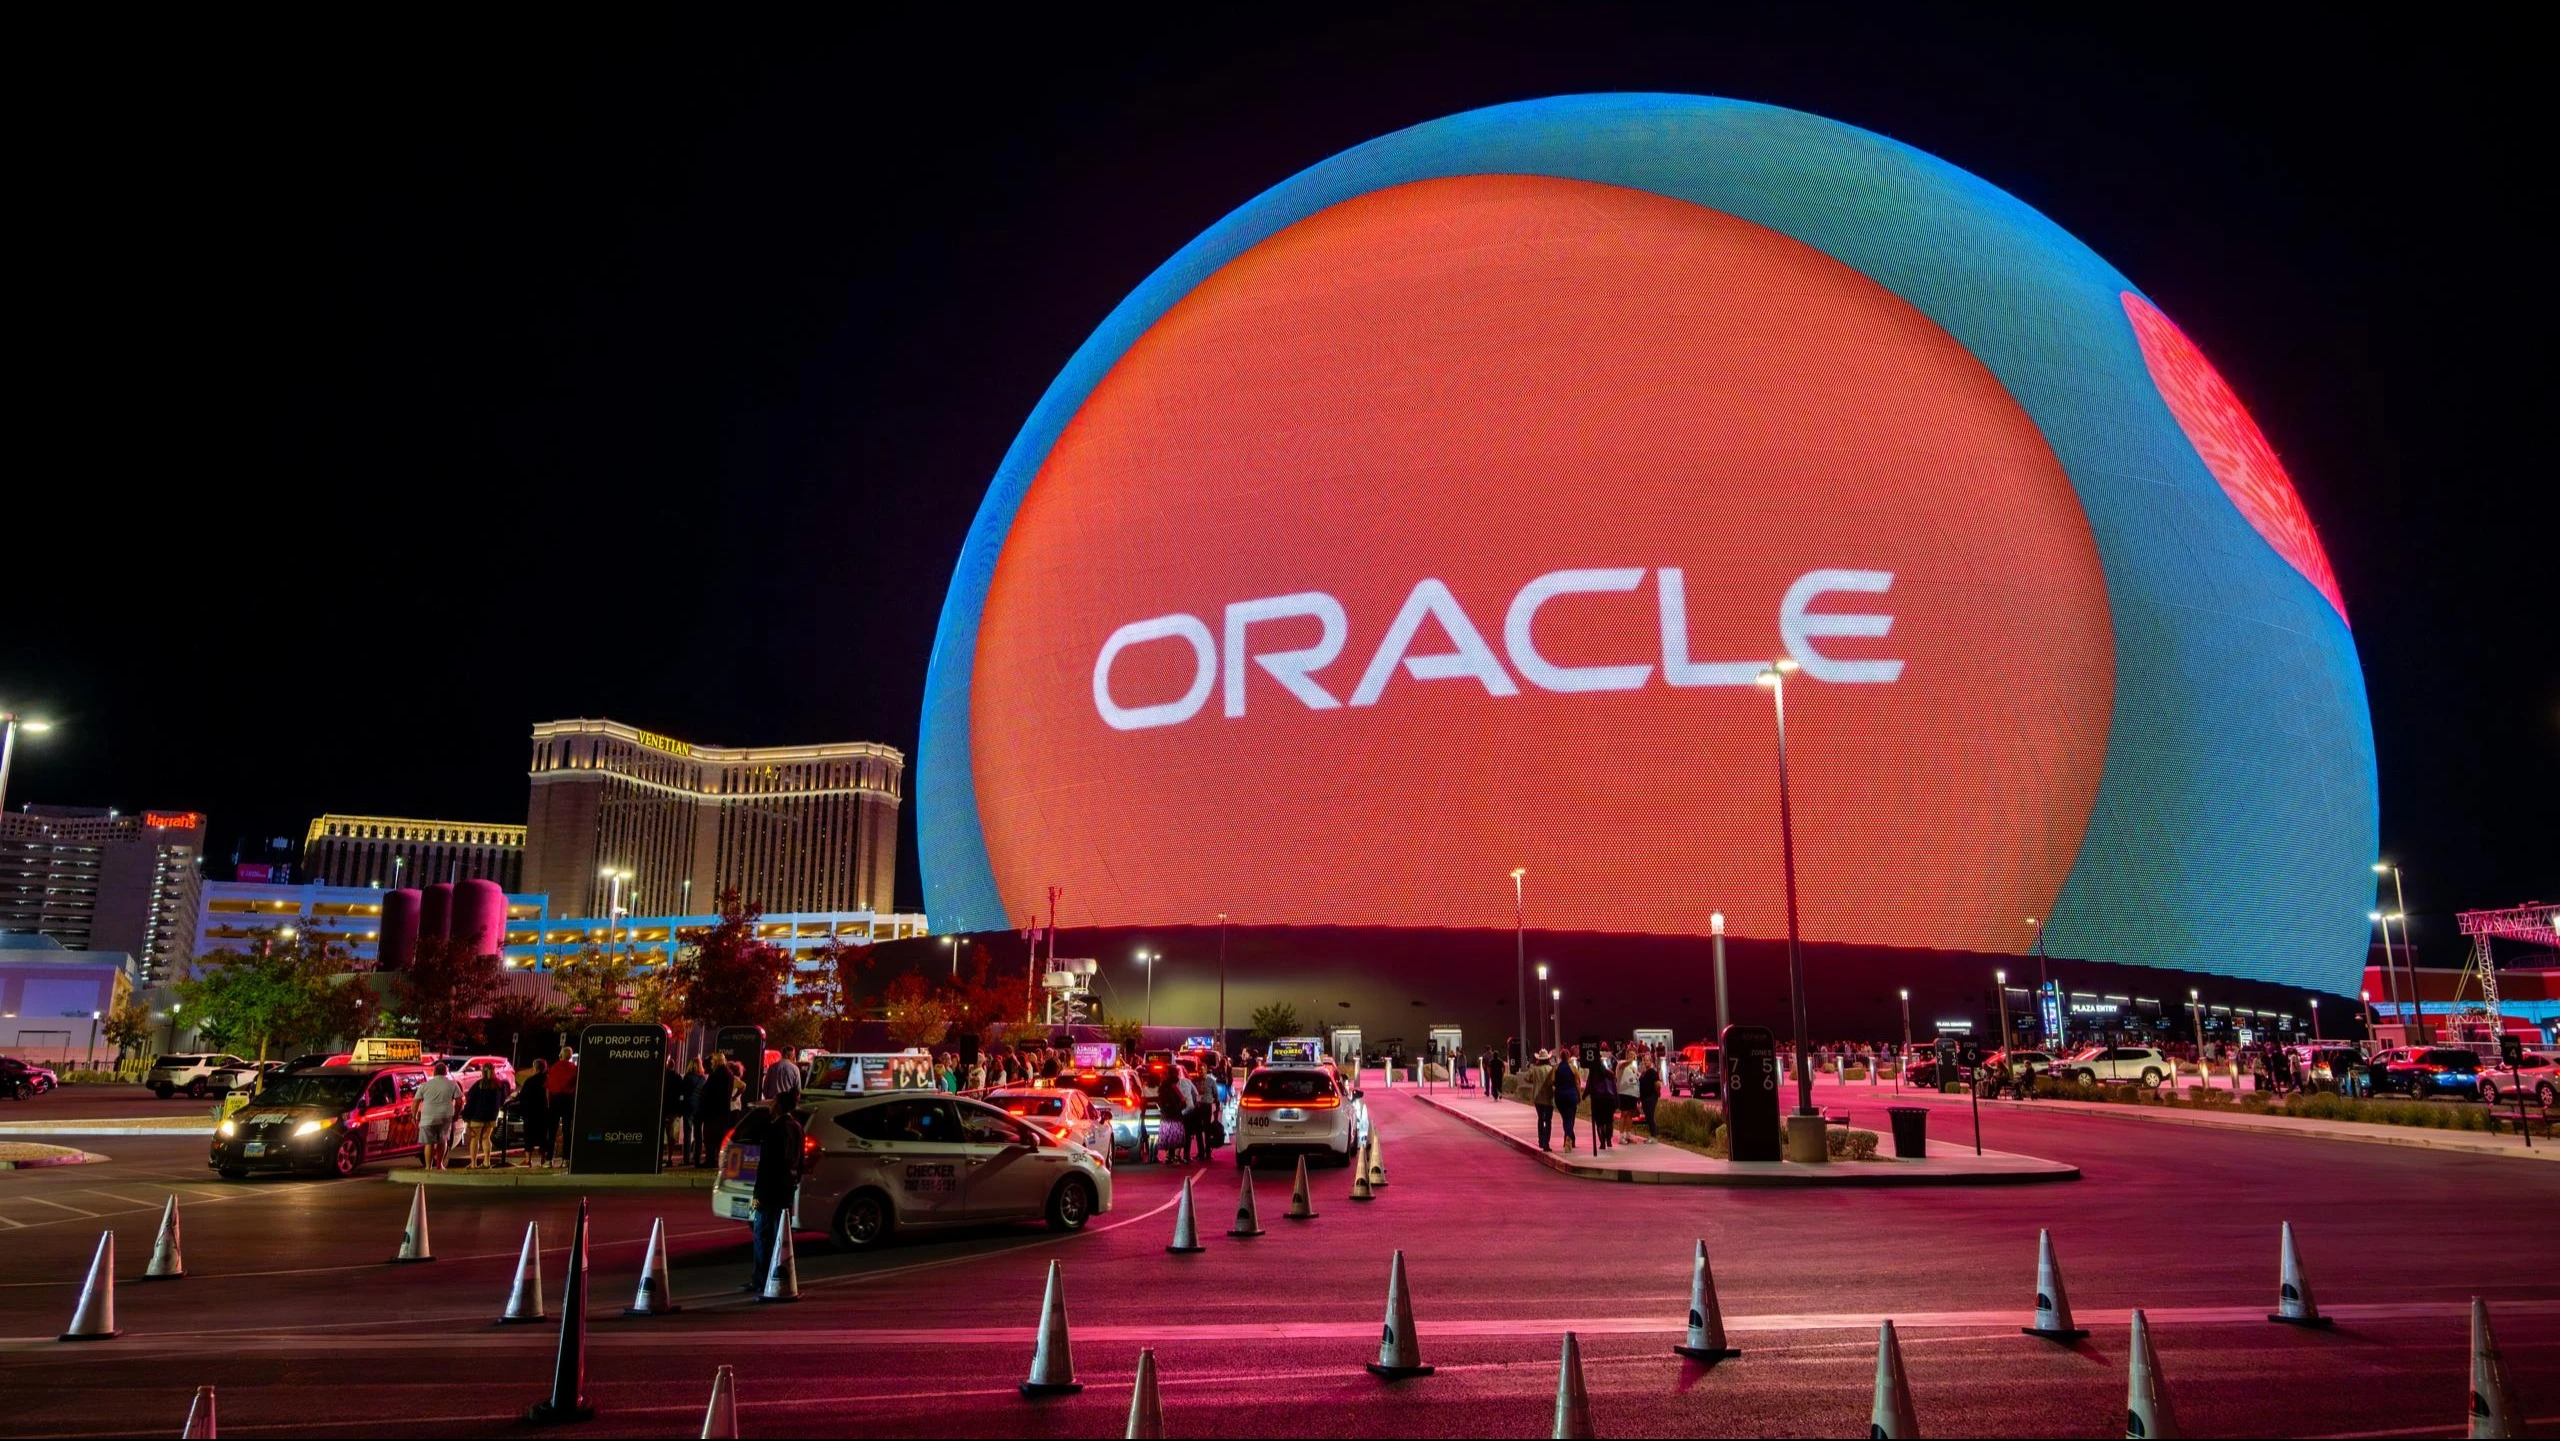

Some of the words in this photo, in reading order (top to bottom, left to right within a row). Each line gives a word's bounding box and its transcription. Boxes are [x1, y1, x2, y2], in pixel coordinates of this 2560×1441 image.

[1092, 567, 1906, 731] ORACLE
[639, 730, 689, 757] VENETIAN
[2072, 1004, 2095, 1012] PLAZA
[2096, 1004, 2117, 1012] ENTRY
[588, 1035, 603, 1045] VIP
[605, 1035, 631, 1045] DROP
[632, 1035, 651, 1045] OFF
[609, 1049, 650, 1059] PARKING
[1586, 1049, 1595, 1062] 8
[1967, 1048, 1976, 1061] 6
[2509, 1047, 2518, 1060] 4
[1728, 1057, 1739, 1073] 7
[1762, 1057, 1773, 1073] 5
[1938, 1058, 1943, 1066] 4
[1951, 1058, 1957, 1066] 2
[1730, 1074, 1742, 1090] 8
[1763, 1074, 1774, 1090] 6
[1248, 1116, 1269, 1127] 4400
[604, 1130, 643, 1144] sphere
[906, 1164, 954, 1177] CHECKER
